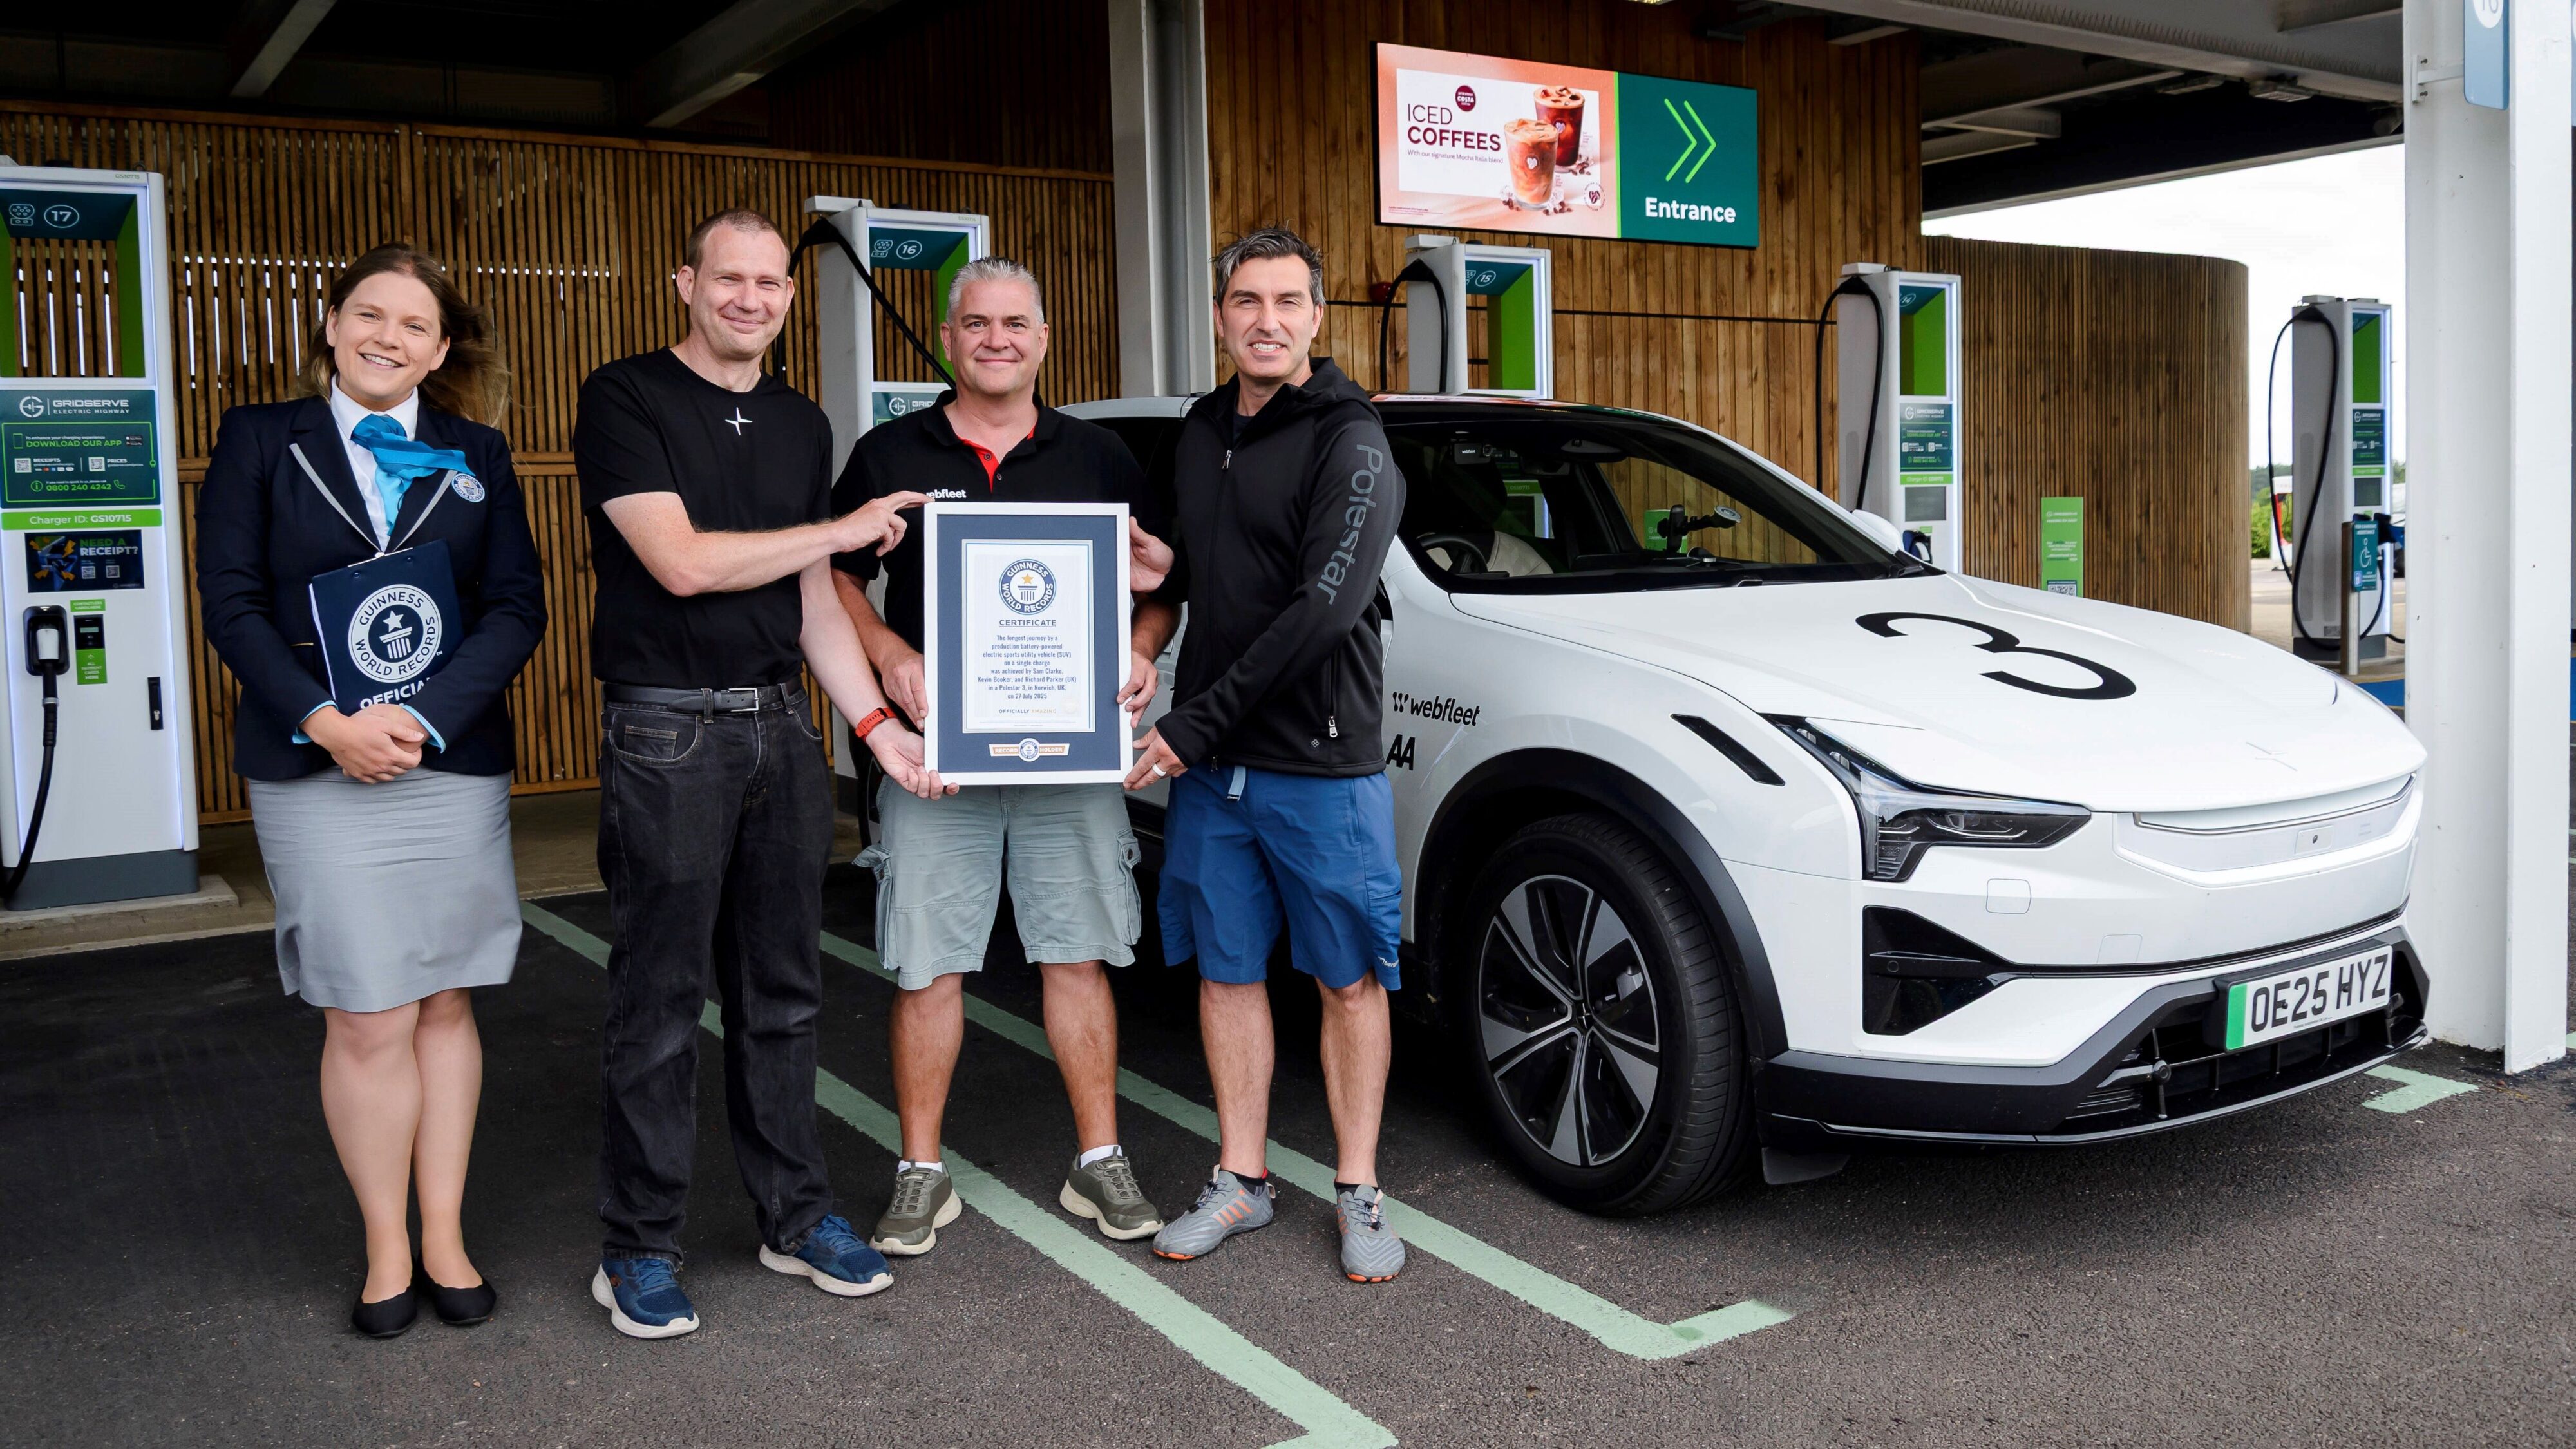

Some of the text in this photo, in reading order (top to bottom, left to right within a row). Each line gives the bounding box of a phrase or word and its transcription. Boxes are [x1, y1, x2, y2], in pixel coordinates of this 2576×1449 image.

[1407, 103, 1453, 125] ICED
[1408, 126, 1501, 152] COFFEES
[51, 211, 72, 222] 17
[1645, 196, 1736, 223] Entrance
[902, 245, 917, 254] 16
[1481, 274, 1492, 283] 15
[52, 399, 129, 408] GRIDSERVE
[29, 515, 132, 526] Charger ID: GS10715
[1317, 444, 1383, 605] Polestar
[79, 538, 127, 547] NEED A
[80, 547, 138, 556] RECEIPT?
[1007, 562, 1049, 578] GUINNESS
[359, 591, 424, 625] GUINNESS
[1002, 582, 1054, 612] WORLD RECORDS
[355, 616, 436, 676] WORLD RECORDS
[1855, 611, 2137, 701] 3
[359, 677, 431, 710] OFFICIA
[1410, 696, 1480, 726] webfleet
[1385, 734, 1416, 770] AA
[2251, 953, 2389, 1032] OE25 HYZ
